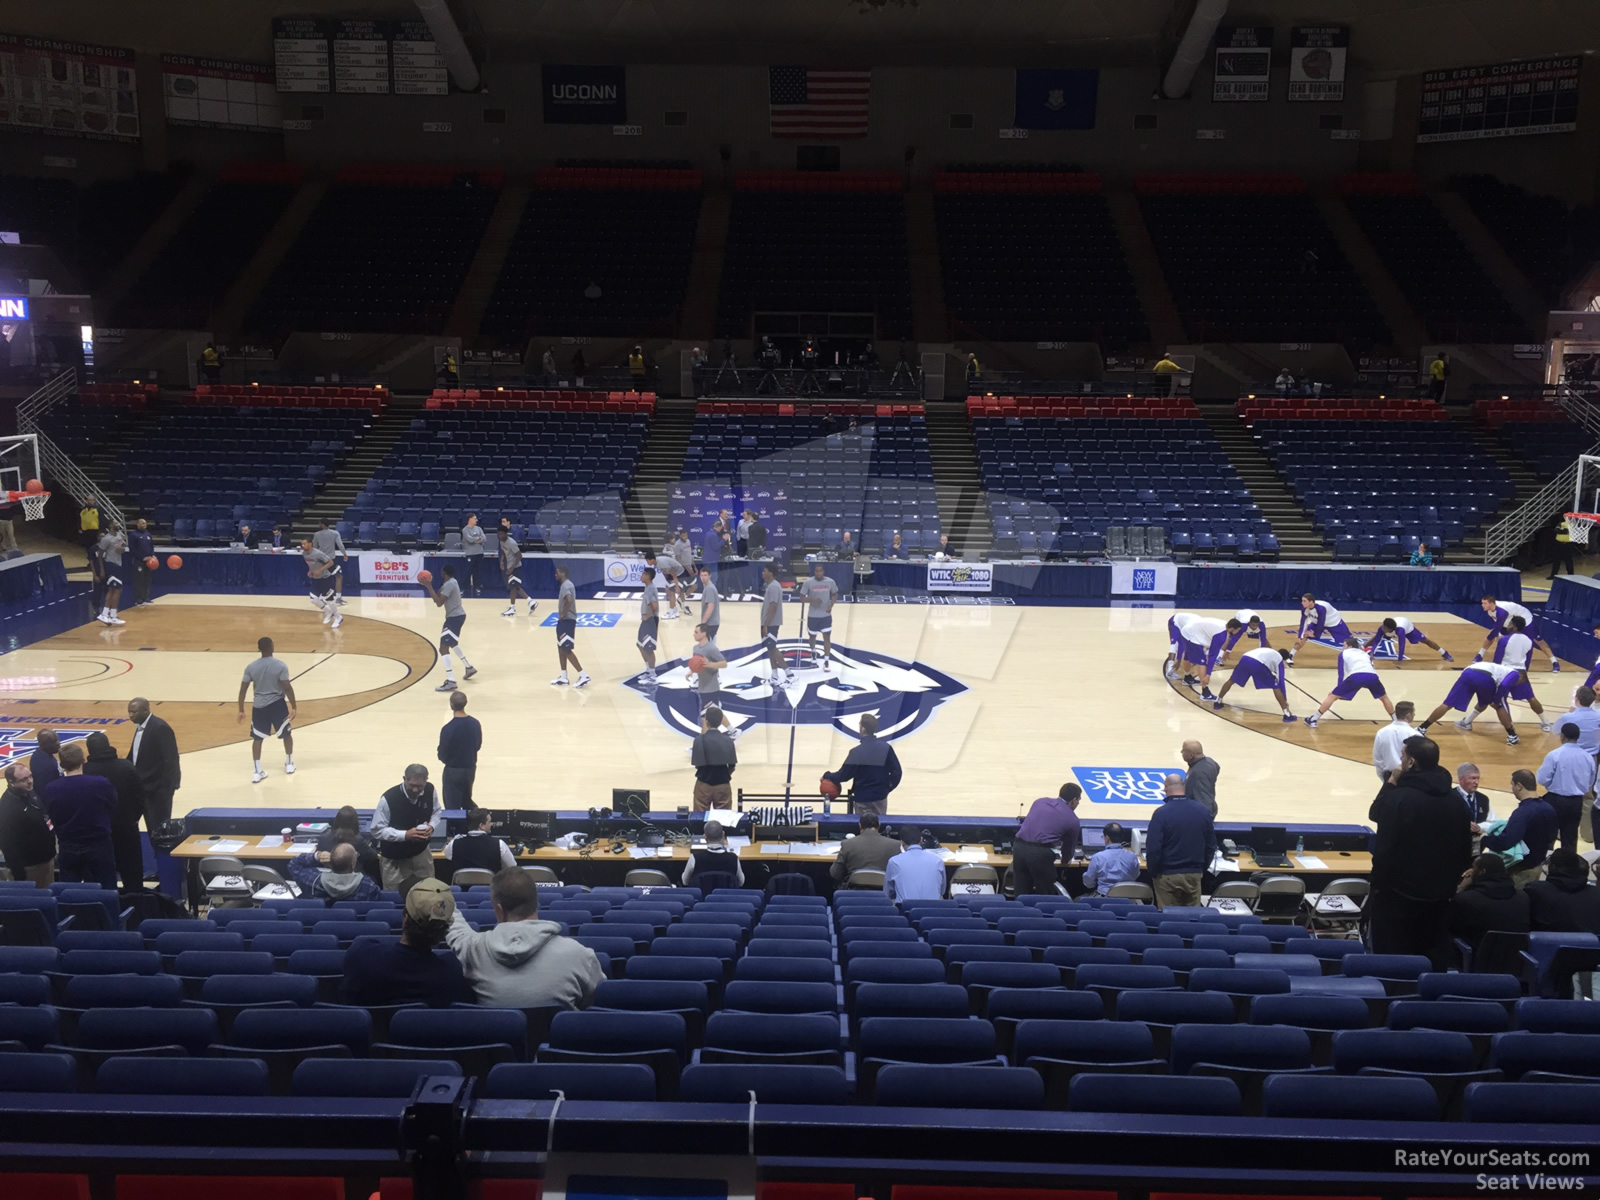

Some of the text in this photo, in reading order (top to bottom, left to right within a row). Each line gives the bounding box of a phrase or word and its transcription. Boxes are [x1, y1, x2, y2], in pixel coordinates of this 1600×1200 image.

[25, 38, 127, 58] CHAMPIONSHIP
[163, 55, 195, 66] NCAA
[1424, 58, 1579, 82] BIG EAST CONFERENCE
[1424, 79, 1469, 90] REGULAR
[1516, 69, 1578, 82] CHAMPIONS
[552, 84, 618, 100] UCONN
[434, 123, 451, 132] 207
[1421, 130, 1480, 142] CONNECTICUT
[1514, 123, 1571, 136] BASKETBALL
[1012, 131, 1028, 139] 210
[374, 561, 409, 572] BOB'S
[931, 570, 951, 580] WTIC
[971, 571, 989, 580] 1080
[1134, 576, 1154, 584] YORK
